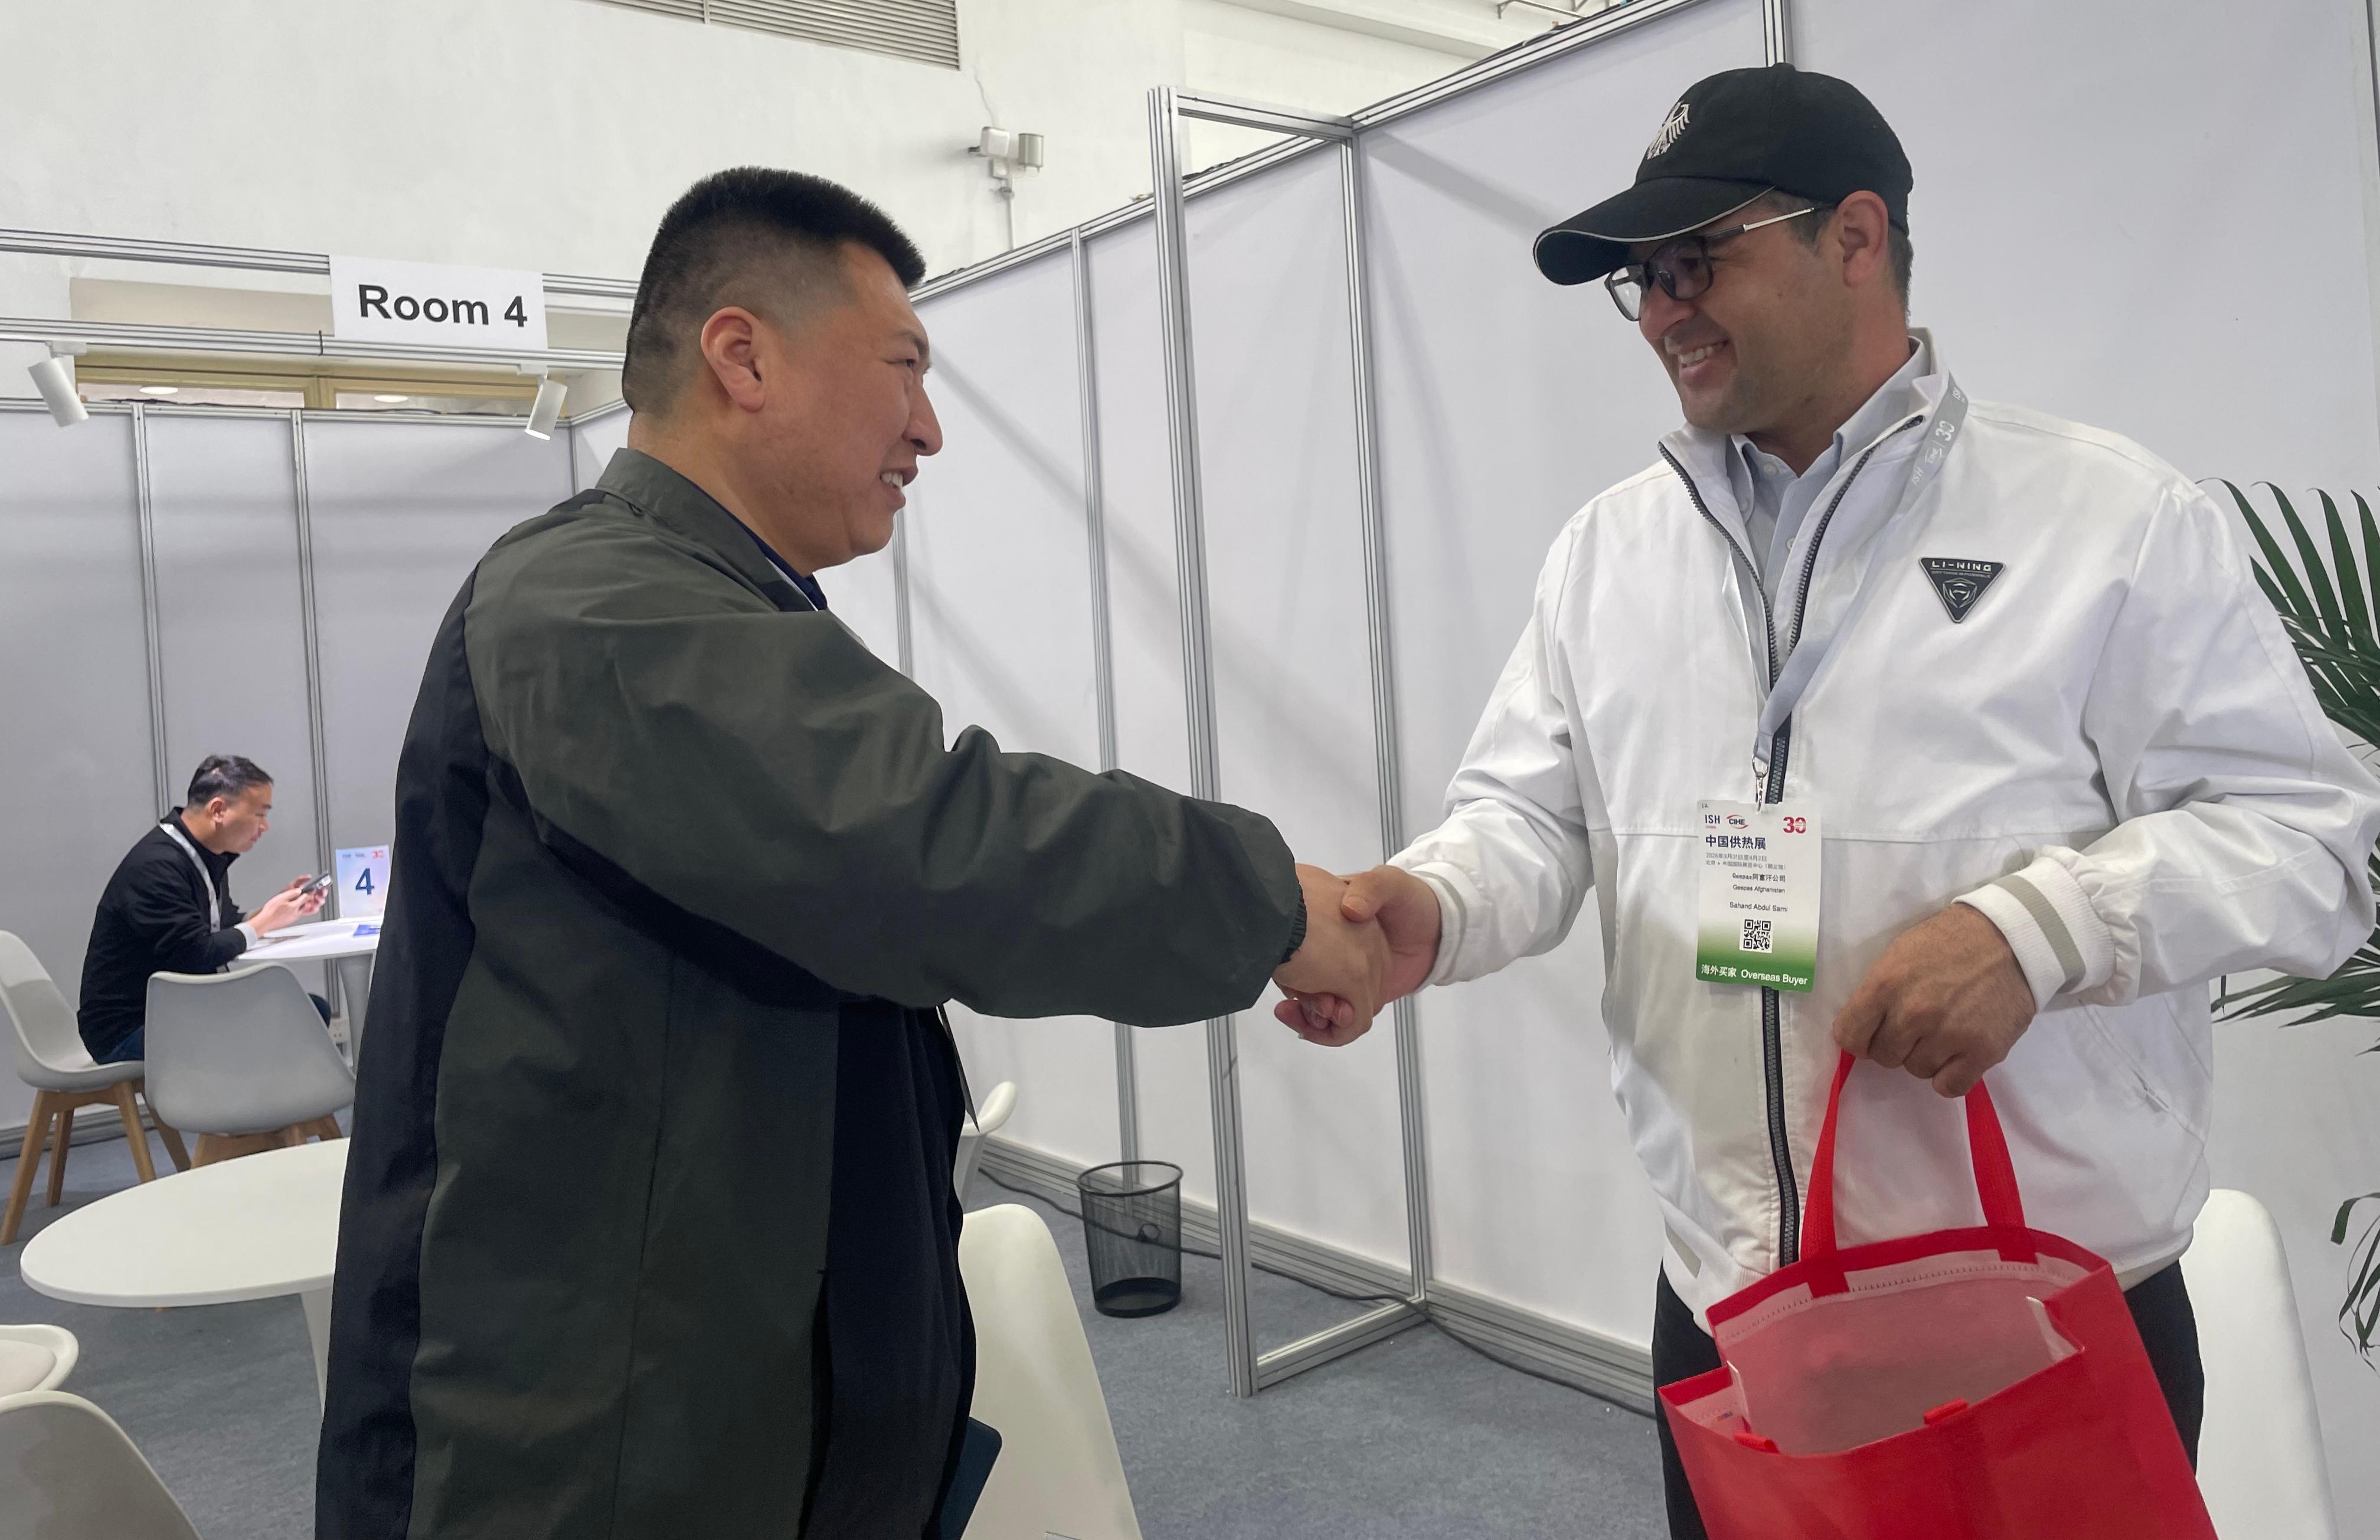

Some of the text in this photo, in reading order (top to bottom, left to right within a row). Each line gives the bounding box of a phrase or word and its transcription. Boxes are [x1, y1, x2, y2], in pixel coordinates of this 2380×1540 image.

[358, 284, 528, 327] Room 4
[1931, 561, 1992, 572] LI-NING
[1705, 815, 1720, 824] ISH
[1783, 817, 1806, 833] 30
[1705, 834, 1766, 850] 中国供热展
[355, 868, 375, 895] 4
[1730, 901, 1752, 910] Sahand
[1701, 964, 1808, 986] 海外买家 Overseas Buyer
